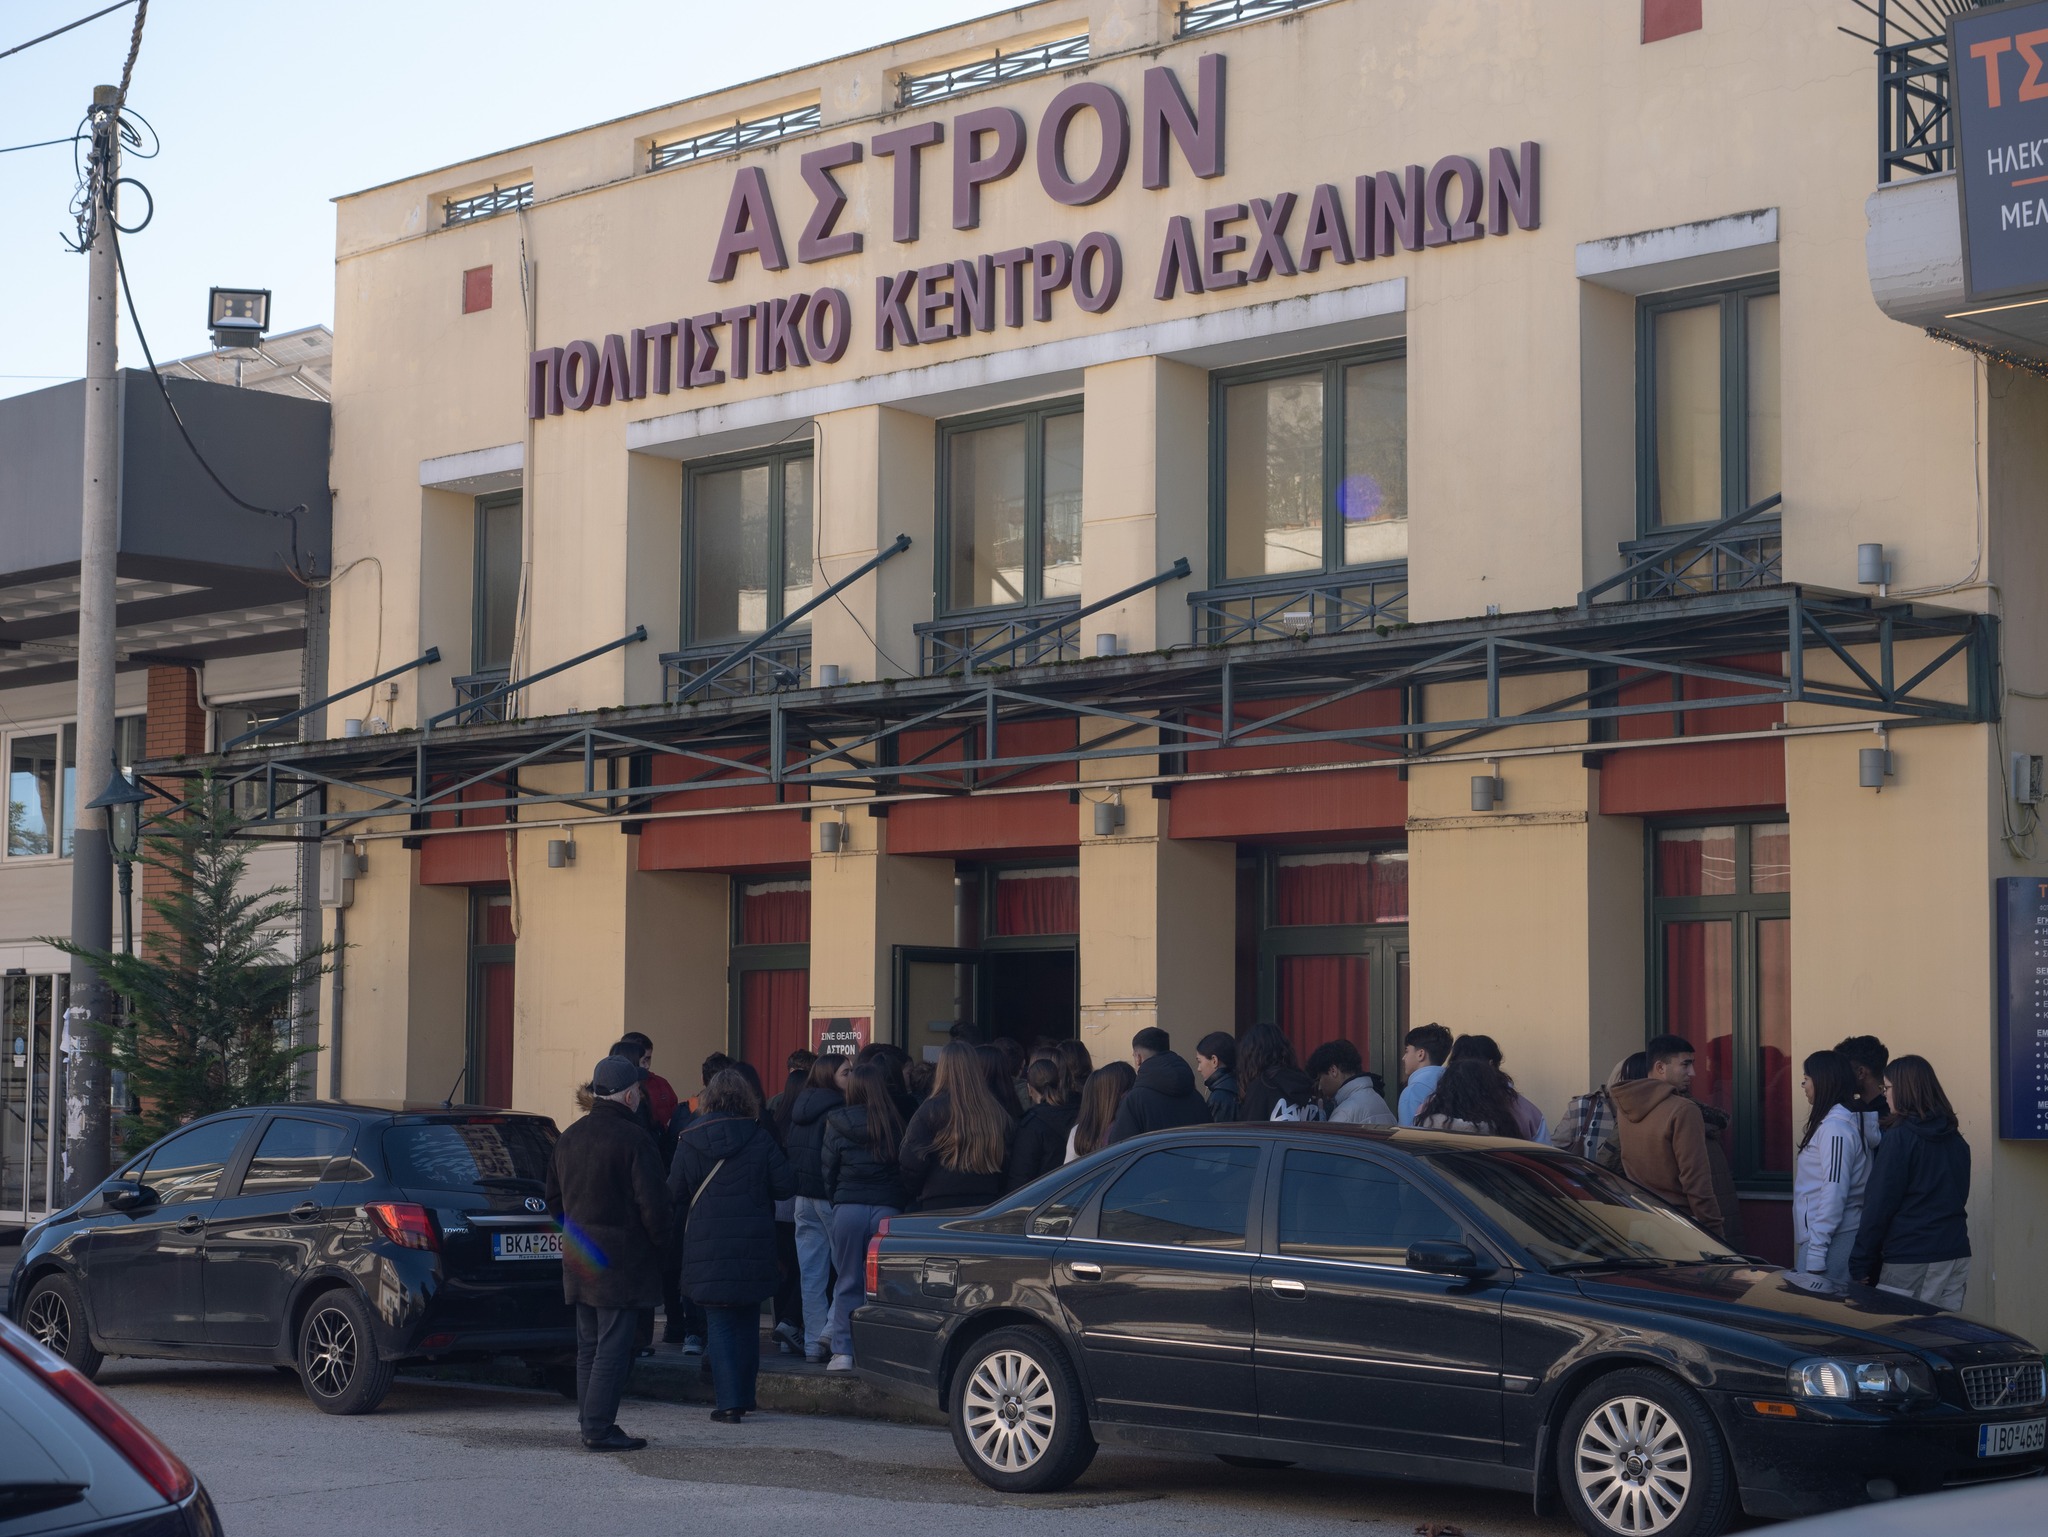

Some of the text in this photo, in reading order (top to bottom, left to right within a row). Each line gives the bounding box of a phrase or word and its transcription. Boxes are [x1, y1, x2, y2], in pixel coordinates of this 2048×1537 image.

[708, 54, 1226, 283] ΑΣΤΡΟΝ
[529, 140, 1540, 420] ΠΟΛΙΤΙΣΤΙΚΟ ΚΕΝΤΡΟ ΛΕΧΑΙΝΩΝ
[821, 1031, 862, 1041] ΣΙΝΕ ΘΕΑΤΡΟ
[826, 1044, 856, 1055] ΑΣΤΡΟΝ
